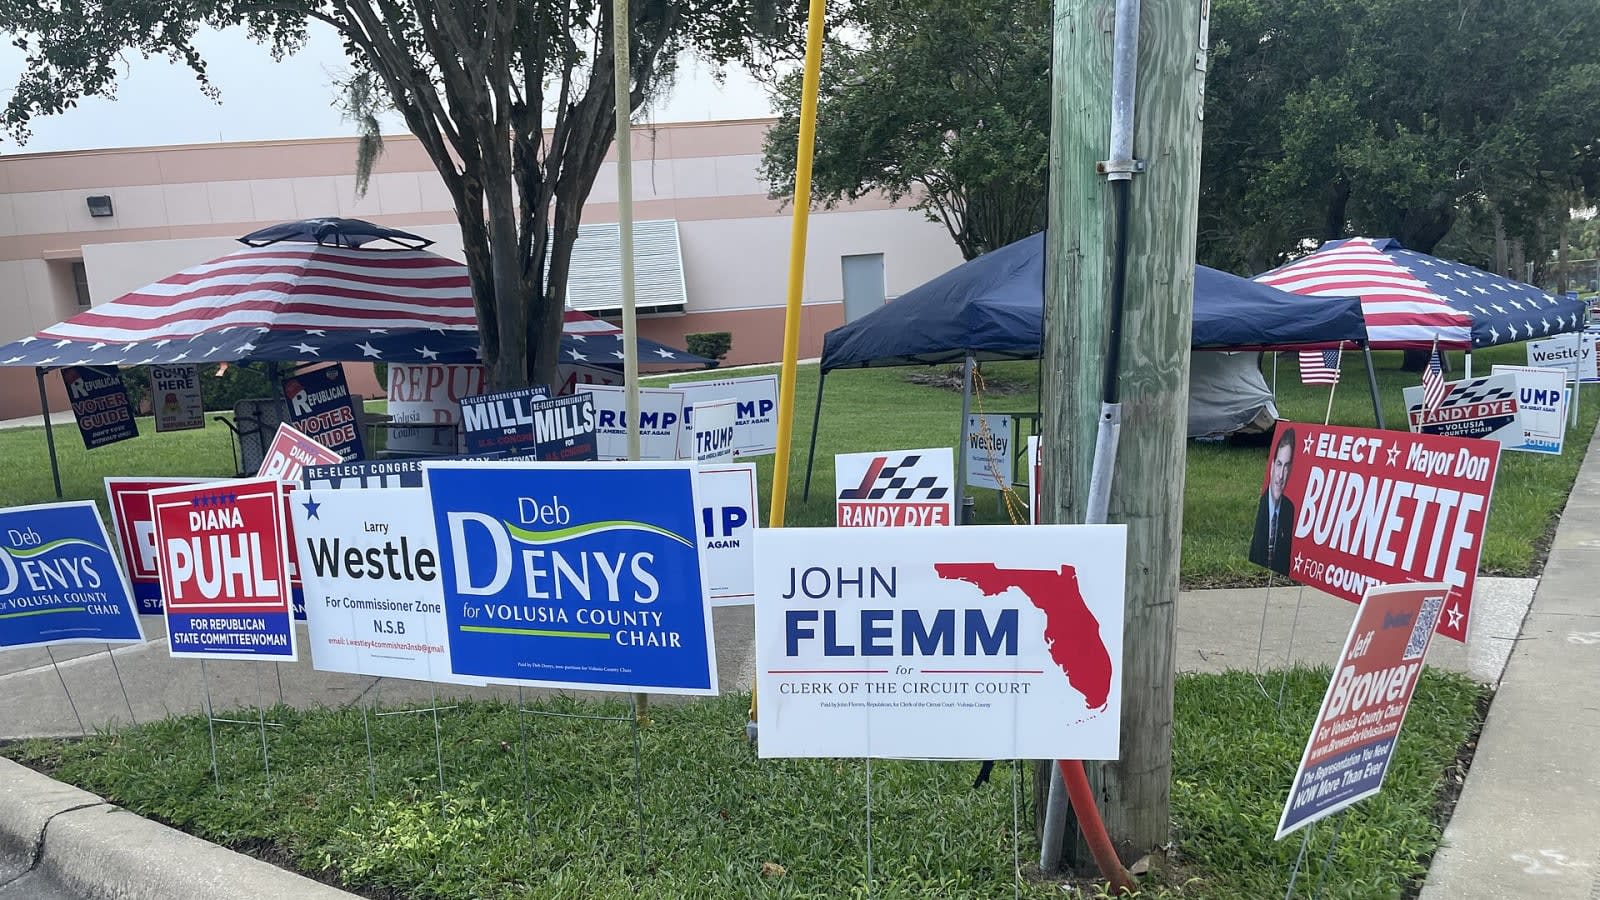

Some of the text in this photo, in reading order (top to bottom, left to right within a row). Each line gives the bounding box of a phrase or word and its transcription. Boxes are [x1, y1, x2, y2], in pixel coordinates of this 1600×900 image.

[1532, 348, 1590, 362] Westley
[153, 367, 195, 379] GUIDE
[71, 378, 120, 398] REPUBLICAN
[158, 379, 194, 390] HERE
[389, 366, 486, 403] REPU
[531, 387, 546, 395] CORY
[72, 392, 128, 416] VOTER
[292, 385, 346, 416] REPUBLICAN
[1520, 388, 1560, 406] UMP
[80, 407, 129, 430] GUIDE
[293, 406, 354, 433] VOTER
[534, 402, 594, 443] MILLS
[1416, 401, 1512, 424] RANDY DYE
[1445, 420, 1484, 430] VOLUSIA
[336, 446, 351, 455] OTE
[696, 426, 733, 453] TRUMP
[970, 433, 1008, 455] Westley
[290, 446, 316, 466] DIANA
[1315, 433, 1490, 482] ELECT Mayor Don
[309, 462, 422, 478] RE-ELECT CONGRES
[189, 507, 244, 532] DIANA
[518, 496, 570, 524] Deb
[840, 506, 944, 526] RANDY DYE
[8, 527, 41, 546] Deb
[364, 521, 388, 534] Larry
[1295, 466, 1485, 587] BURNETTE
[707, 540, 740, 549] AGAIN
[167, 533, 278, 599] PUHL
[307, 536, 436, 581] Westle
[447, 512, 660, 603] DENYS
[782, 566, 897, 599] JOHN
[1303, 558, 1388, 596] FOR COUNT
[8, 595, 61, 608] VOLUSIA
[64, 592, 107, 602] COUNTY
[88, 605, 120, 615] CHAIR
[144, 599, 164, 608] STA
[325, 597, 441, 613] For Commissioner Zone
[190, 619, 265, 630] FOR REPUBLICAN
[463, 602, 663, 627] for VOLUSIA COUNTY
[374, 620, 405, 634] N.S.B
[785, 609, 1019, 657] FLEMM
[175, 633, 287, 645] STATE COMMITTEEWOMAN
[616, 630, 681, 648] CHAIR
[1348, 631, 1375, 660] Jeff
[896, 665, 914, 675] for
[780, 682, 1031, 694] CLERK OF THE CIRCUIT COURT
[1324, 663, 1419, 721] Brower
[1317, 704, 1404, 742] For Volusia County Chair
[1311, 722, 1396, 760] www.BrowerForVolusia.com
[1301, 742, 1390, 787] The Representation You Need
[1293, 790, 1318, 810] NOW
[1318, 779, 1339, 796] More
[1342, 768, 1362, 788] Than
[1364, 761, 1383, 778] Ever
